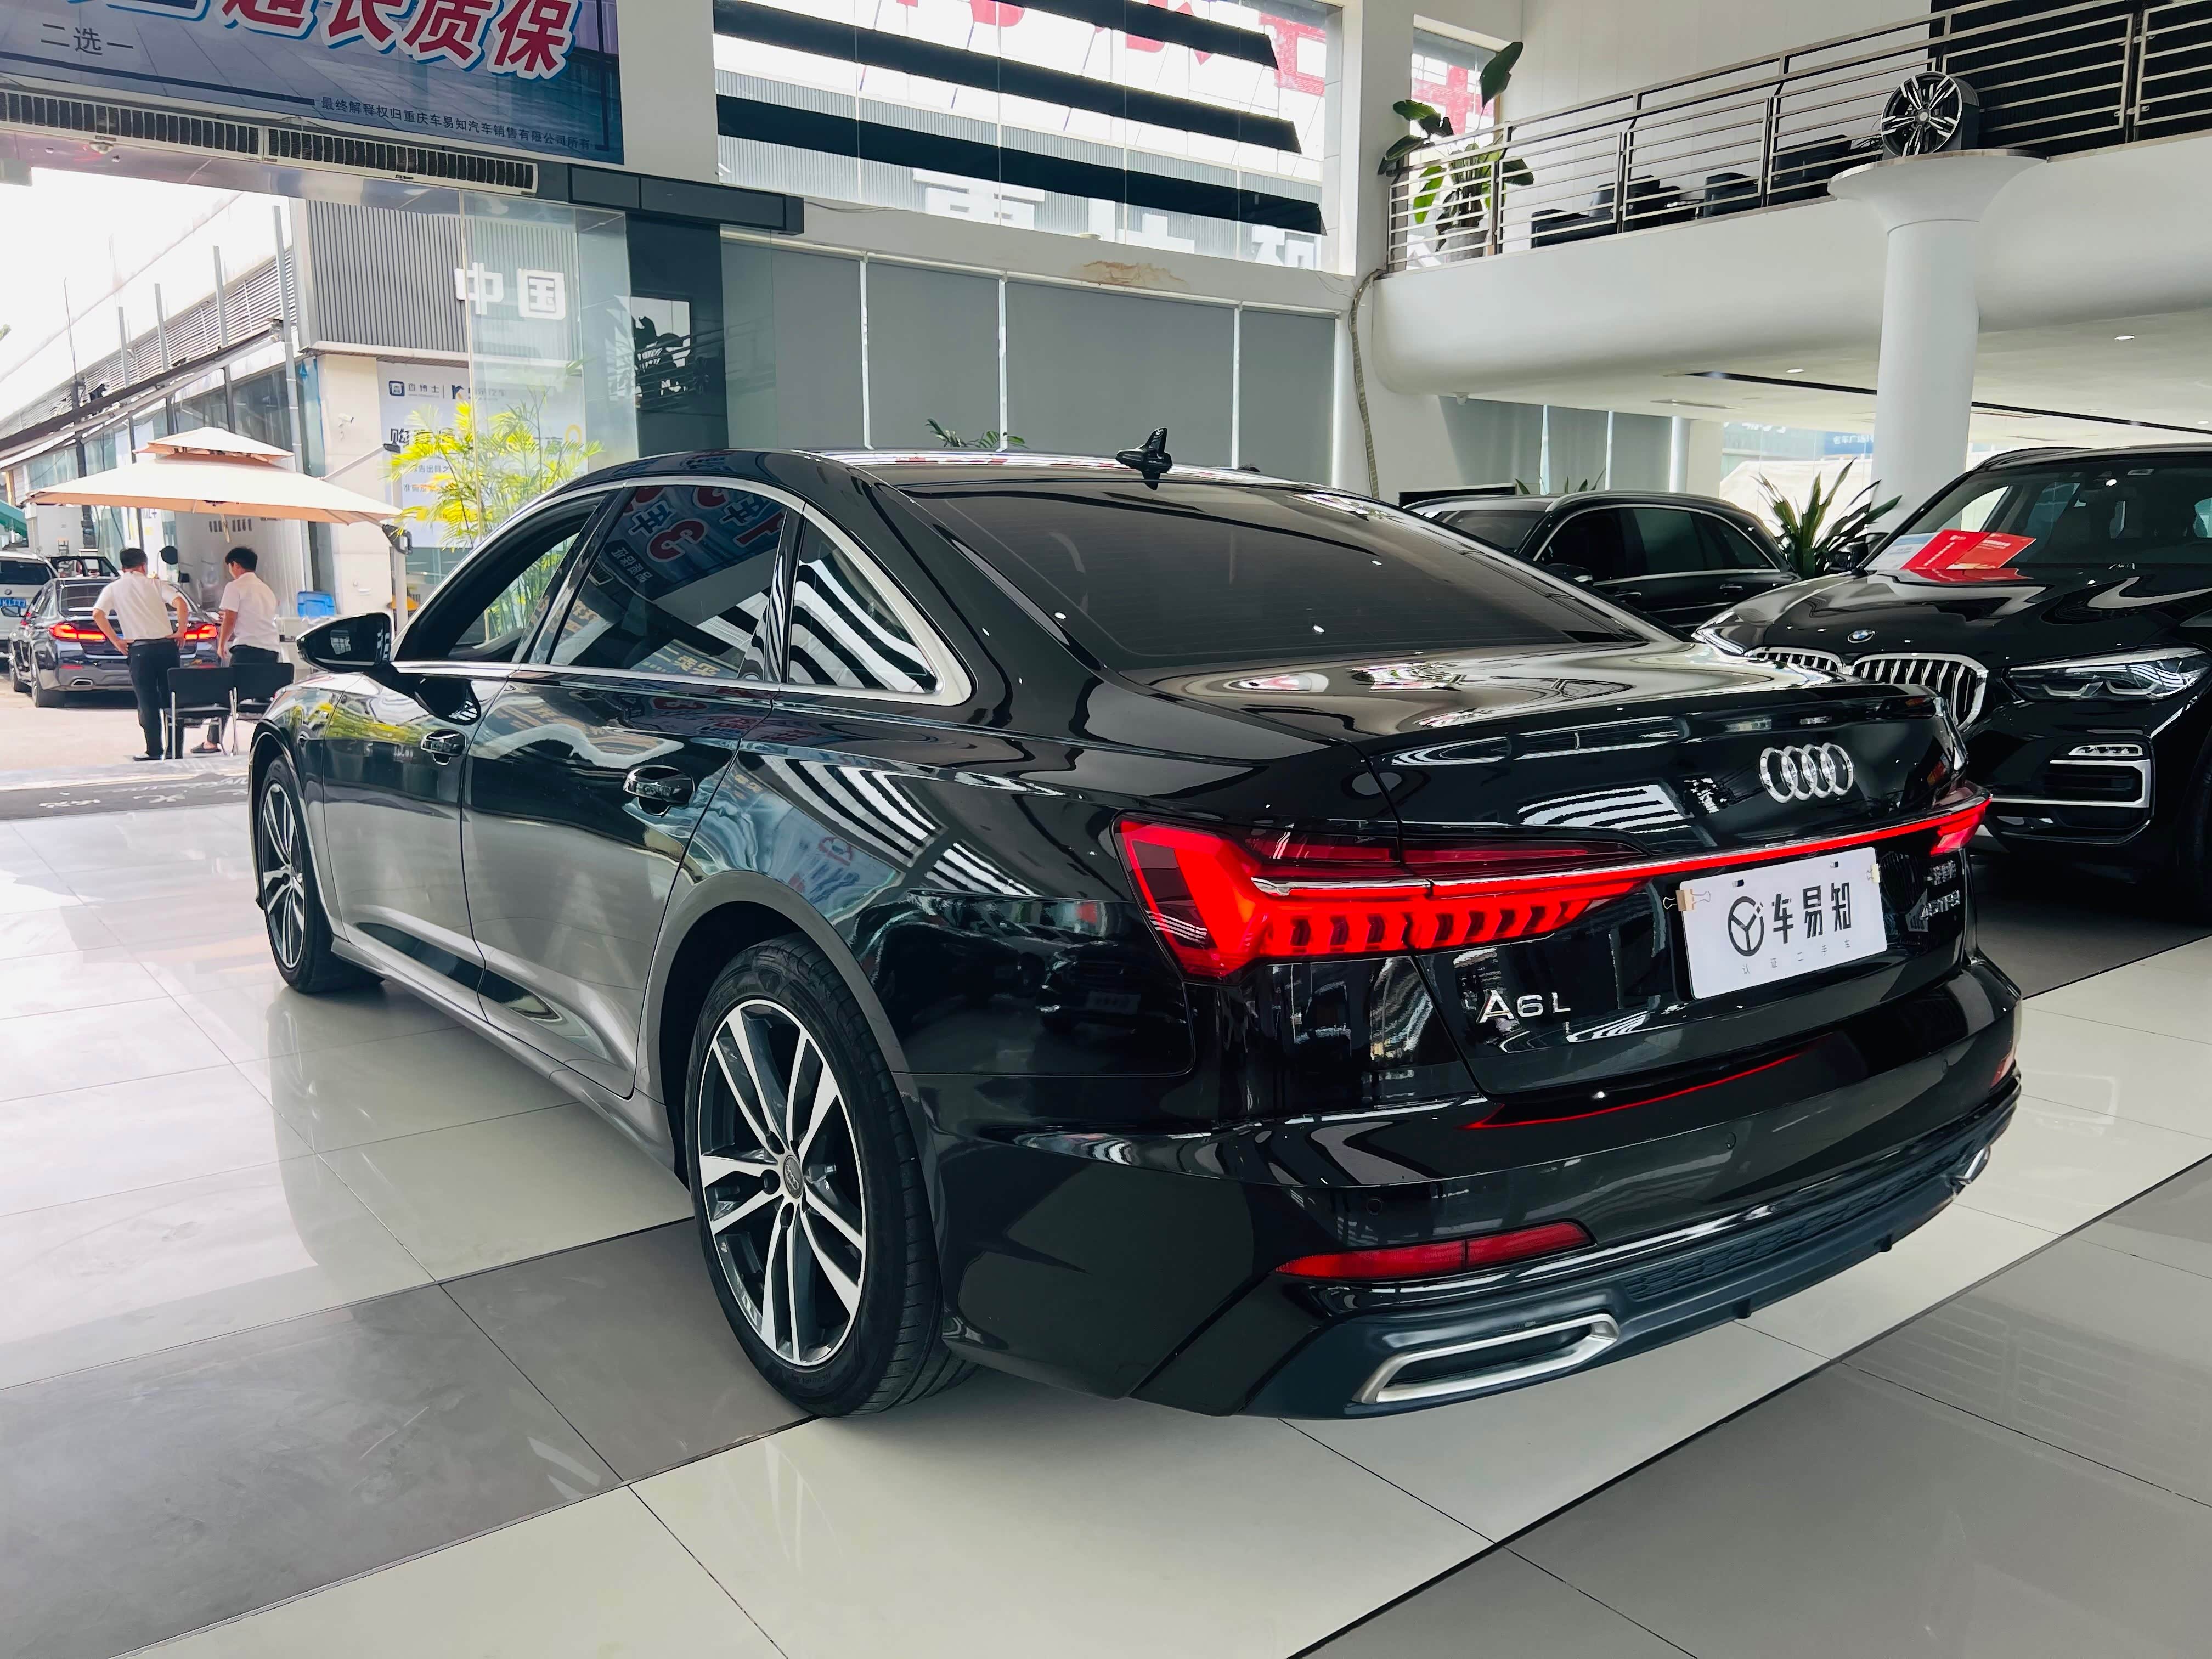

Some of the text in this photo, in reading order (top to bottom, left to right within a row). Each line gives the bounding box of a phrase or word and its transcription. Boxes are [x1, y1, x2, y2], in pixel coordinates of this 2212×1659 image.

[41, 23, 133, 55] 二选一
[321, 96, 590, 151] 最终解释权归重庆车易知汽车销售有限公司所有
[455, 262, 566, 320] 中国
[1771, 882, 1852, 944] 车易知
[1742, 939, 1850, 975] 认证二手车
[1477, 990, 1571, 1024] A6L
